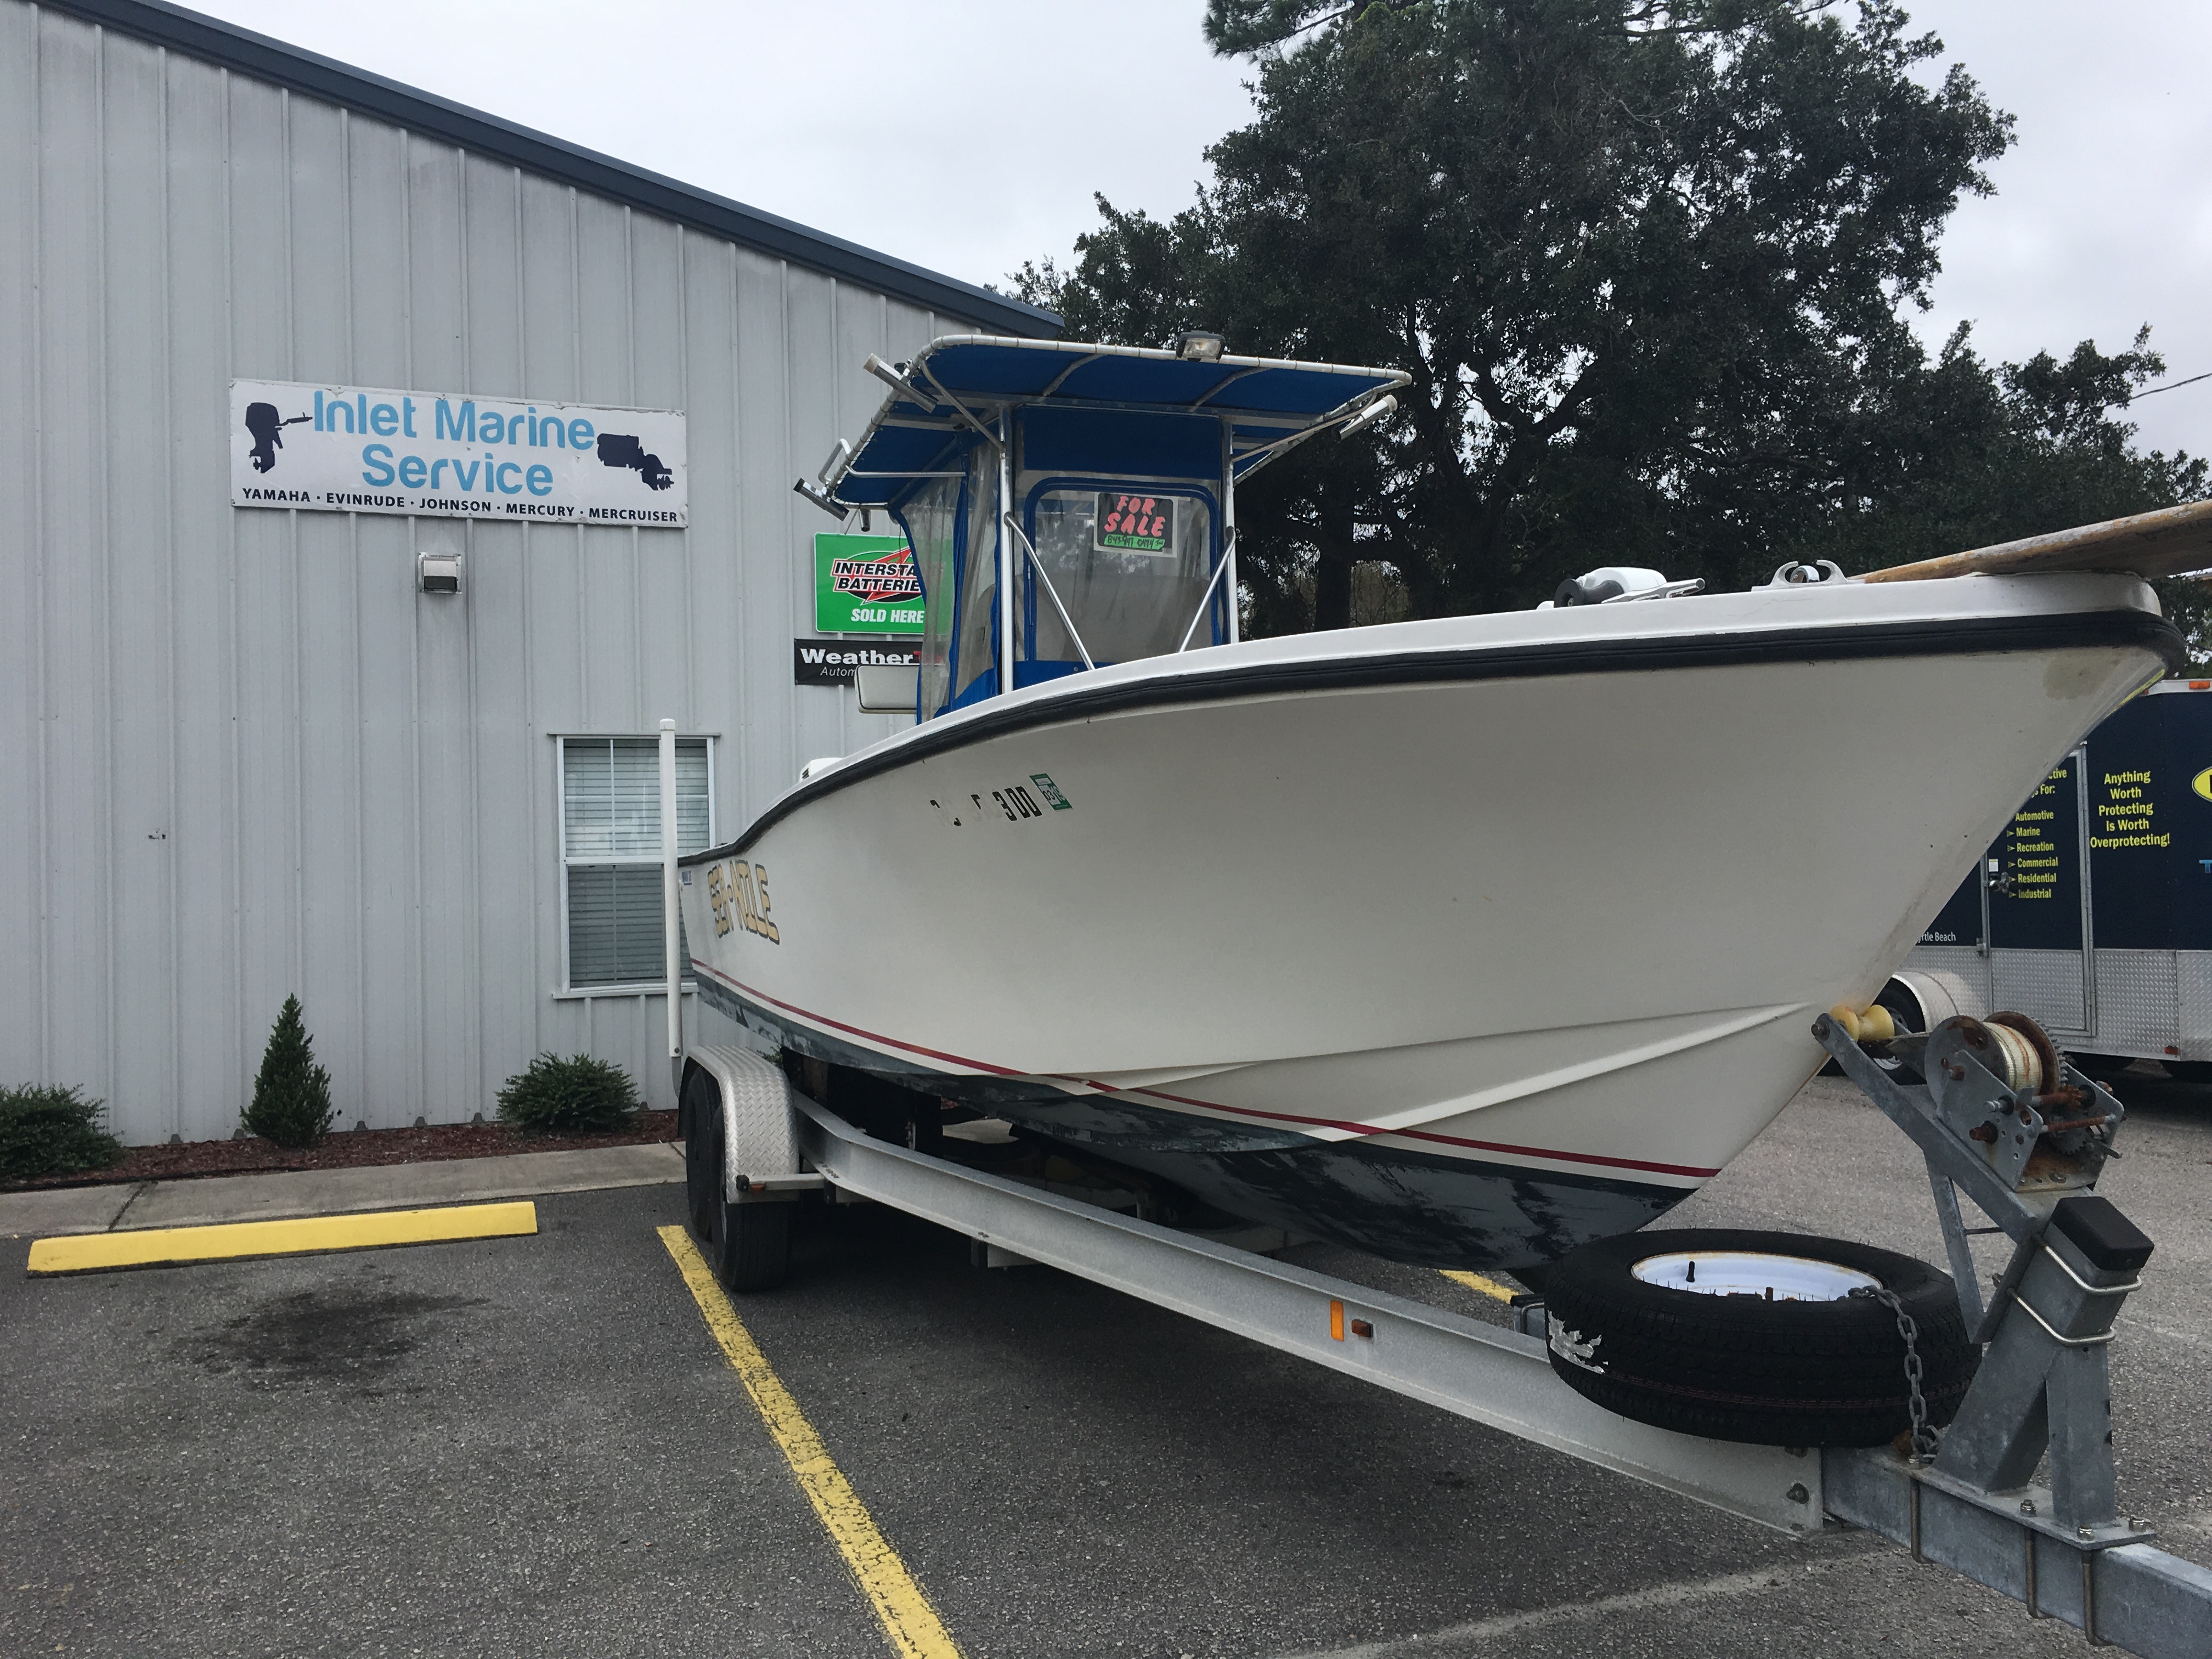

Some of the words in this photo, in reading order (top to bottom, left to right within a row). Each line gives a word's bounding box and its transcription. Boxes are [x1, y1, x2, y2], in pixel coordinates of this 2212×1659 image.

[314, 390, 417, 438] Inlet
[435, 399, 595, 450] Marine
[362, 443, 554, 496] Service
[242, 488, 311, 503] YAMAHA
[326, 492, 405, 508] EVINRUDE
[419, 498, 491, 512] JOHNSON
[506, 503, 575, 517] MERCURY
[589, 507, 678, 522] MERCRUISER
[1116, 495, 1155, 515] FOR
[1104, 512, 1166, 537] SALE
[834, 561, 915, 576] INTERSTA
[838, 577, 920, 591] BATTERIE
[851, 608, 887, 623] SOLD
[890, 610, 925, 624] HERE
[800, 648, 922, 665] WeatherT
[820, 666, 856, 676] Autom
[2104, 770, 2151, 786] Anything
[2040, 783, 2055, 794] For:
[2110, 786, 2142, 800] Worth
[992, 786, 1042, 821] 300
[2098, 802, 2154, 816] Protecting
[2015, 810, 2054, 821] Automotive
[2016, 826, 2041, 837] Marine
[2106, 820, 2115, 832] Is
[2117, 818, 2149, 831] Worth
[2017, 841, 2054, 852] Recreation
[2090, 833, 2170, 850] Overprotecting!
[2017, 856, 2058, 868] Commercial
[2018, 872, 2057, 883] Residential
[2018, 888, 2051, 899] Industrial
[1918, 932, 1934, 944] rtle
[1934, 932, 1956, 941] Beach
